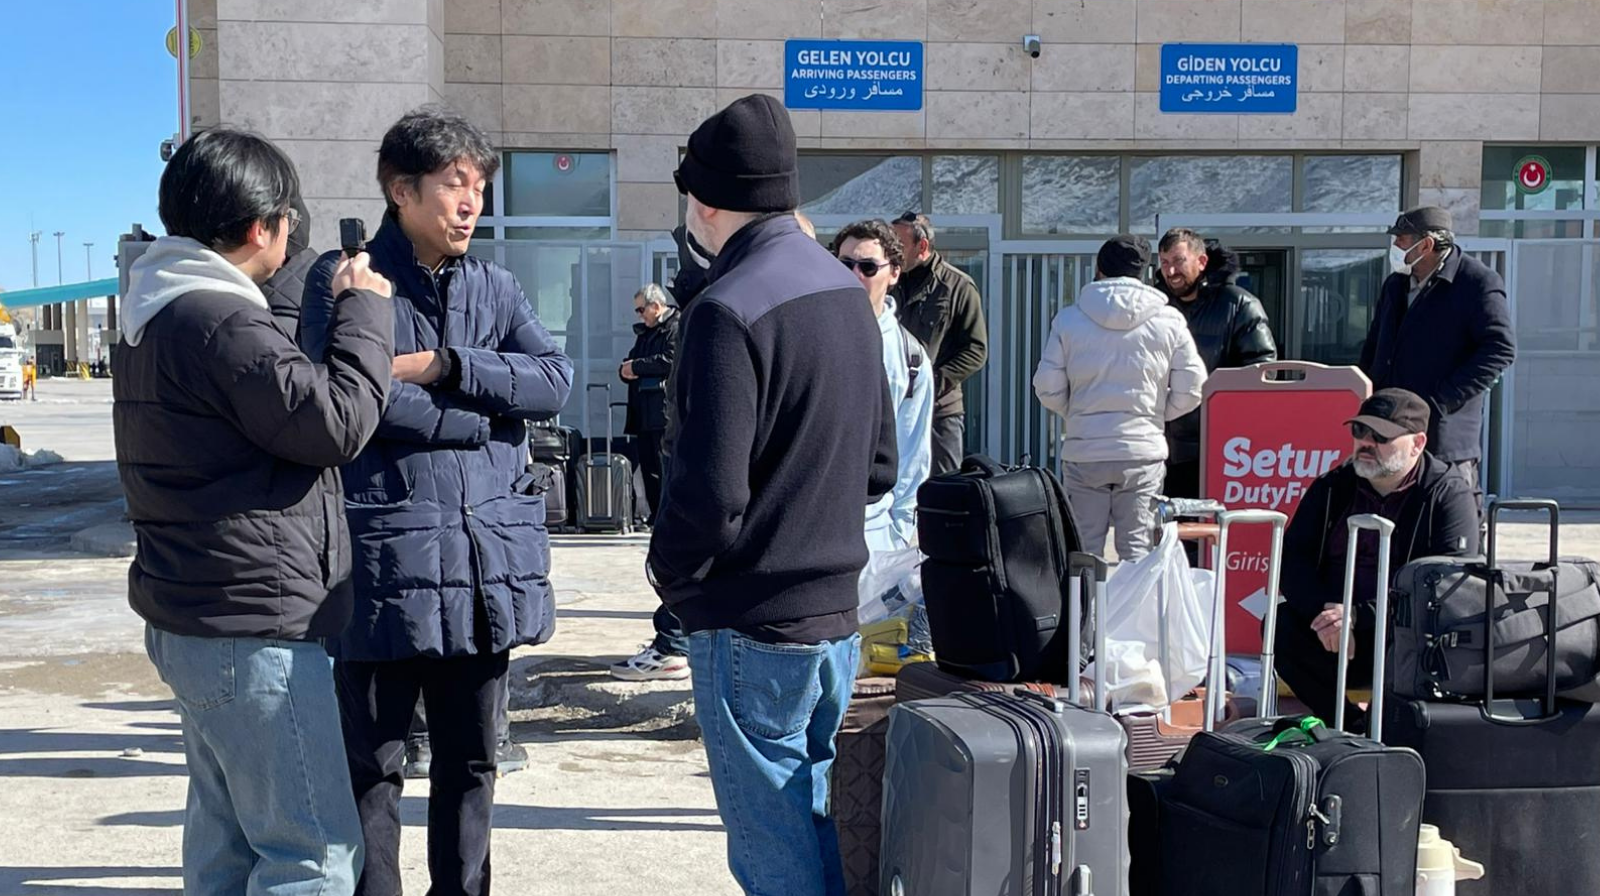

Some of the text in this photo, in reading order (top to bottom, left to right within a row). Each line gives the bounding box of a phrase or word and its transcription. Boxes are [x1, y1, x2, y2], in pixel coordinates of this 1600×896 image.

[798, 50, 911, 66] GELEN YOLCU
[1177, 55, 1281, 72] GİDEN YOLCU
[791, 69, 917, 80] ARRIVING PASSENGERS
[1166, 75, 1291, 85] DEPARTING PASSENGERS
[862, 81, 903, 100] مسافر
[1237, 85, 1275, 101] مسافر
[1223, 436, 1340, 478] Setur
[1226, 551, 1269, 573] Giriş
